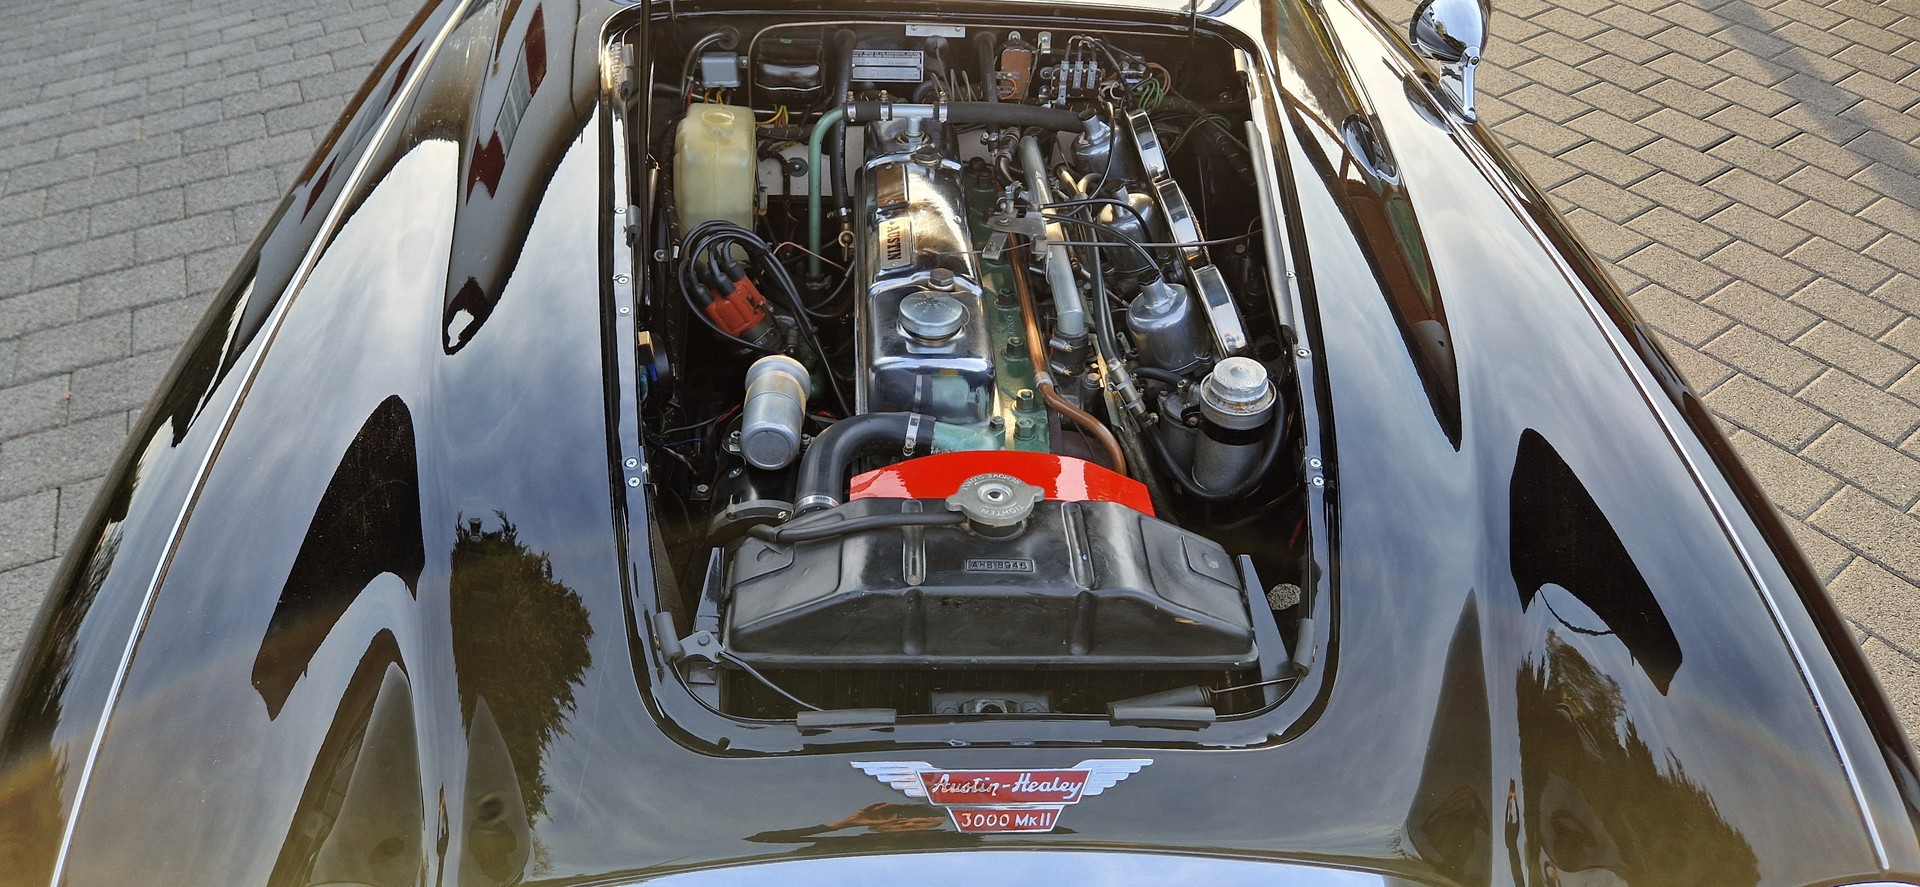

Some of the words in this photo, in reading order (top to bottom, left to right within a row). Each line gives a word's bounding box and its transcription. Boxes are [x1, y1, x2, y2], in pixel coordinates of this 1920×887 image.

[887, 226, 902, 260] AUSTIN
[988, 473, 1021, 485] REMOVE
[981, 505, 1026, 517] TIGHTEN
[971, 561, 993, 569] AHB
[932, 772, 1083, 800] Austin-Healey
[961, 812, 1010, 828] 3000
